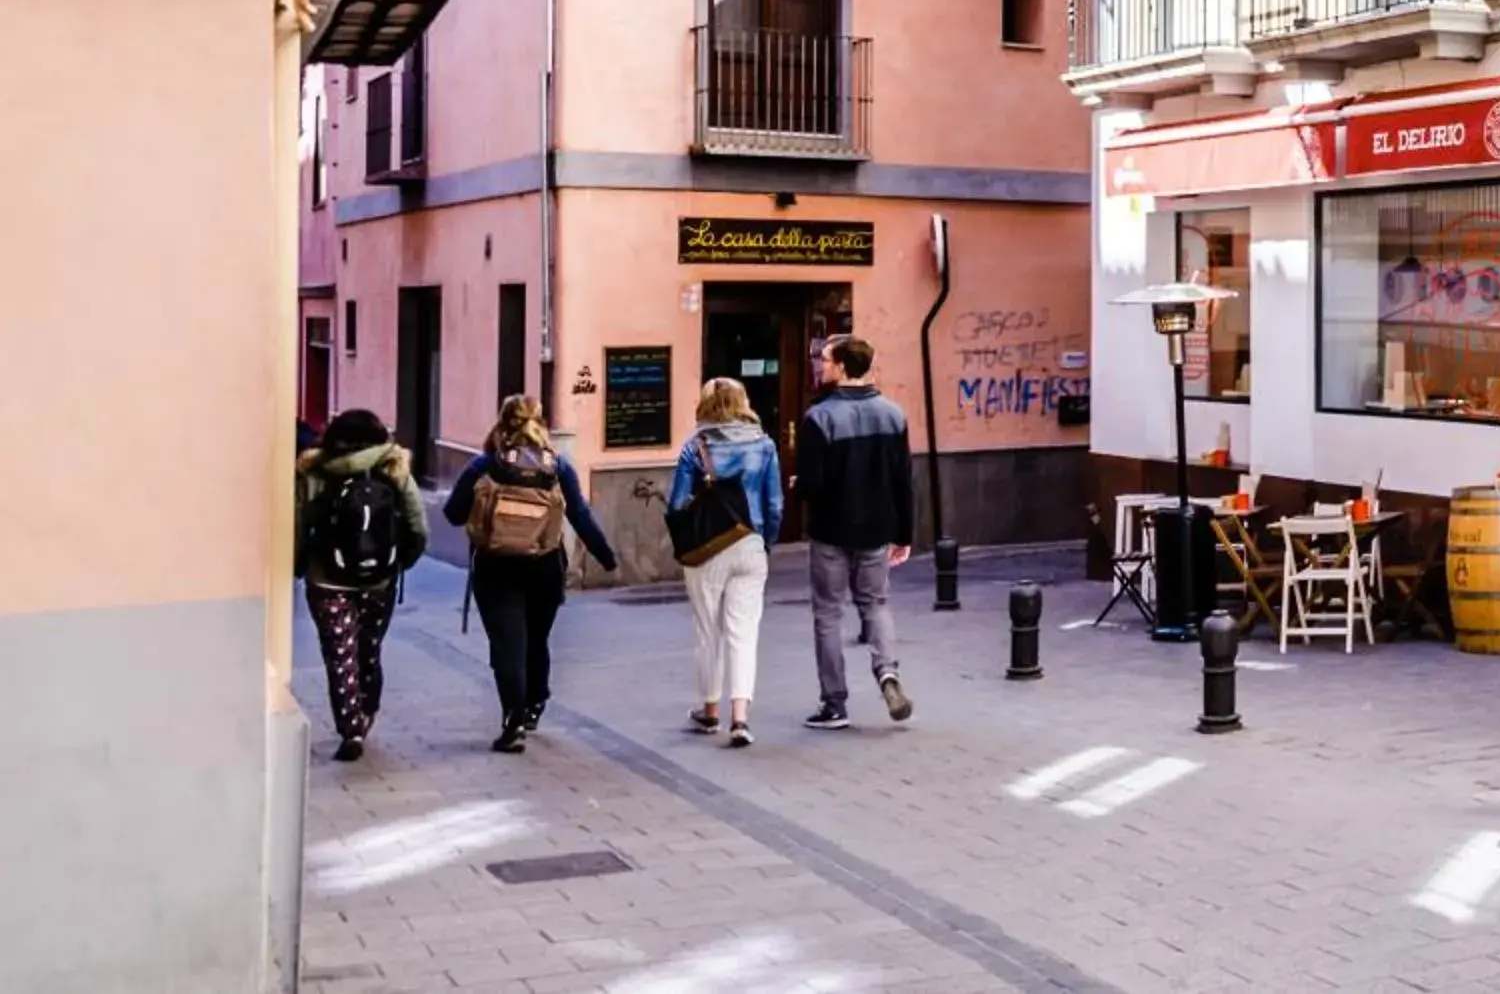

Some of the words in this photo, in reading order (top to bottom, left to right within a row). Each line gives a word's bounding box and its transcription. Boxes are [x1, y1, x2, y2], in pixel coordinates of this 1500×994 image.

[1372, 133, 1393, 154] EL
[1398, 122, 1465, 151] DELIRIO
[684, 220, 717, 248] La
[719, 232, 765, 249] casa
